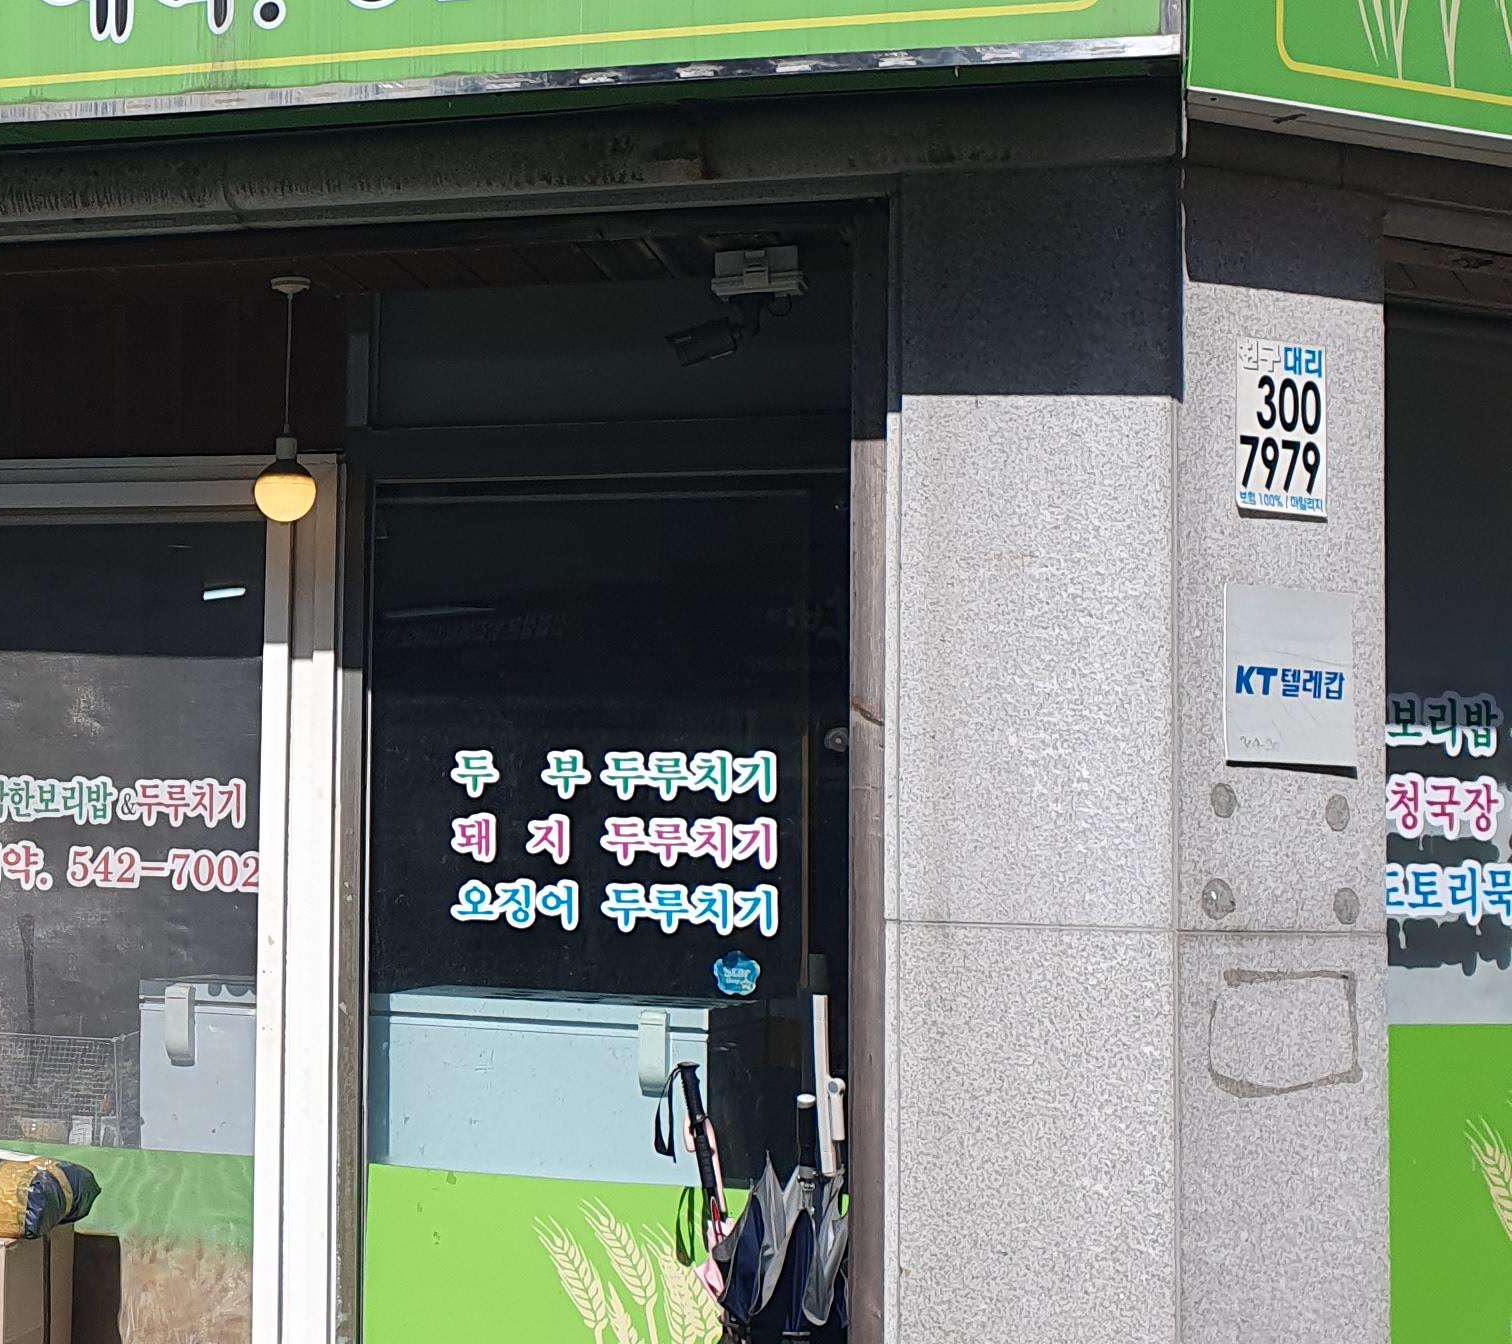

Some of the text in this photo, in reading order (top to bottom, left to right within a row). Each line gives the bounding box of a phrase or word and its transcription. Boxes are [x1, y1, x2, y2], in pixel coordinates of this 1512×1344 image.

[1256, 375, 1322, 435] 300
[1239, 435, 1322, 495] 7979
[1387, 697, 1499, 750] 보리밥
[605, 754, 774, 798] 두루치기
[1388, 778, 1500, 834] 청국장
[605, 820, 774, 864] 두루치기
[70, 850, 260, 889] 542-7002
[455, 885, 774, 932] 오징어 두루치기
